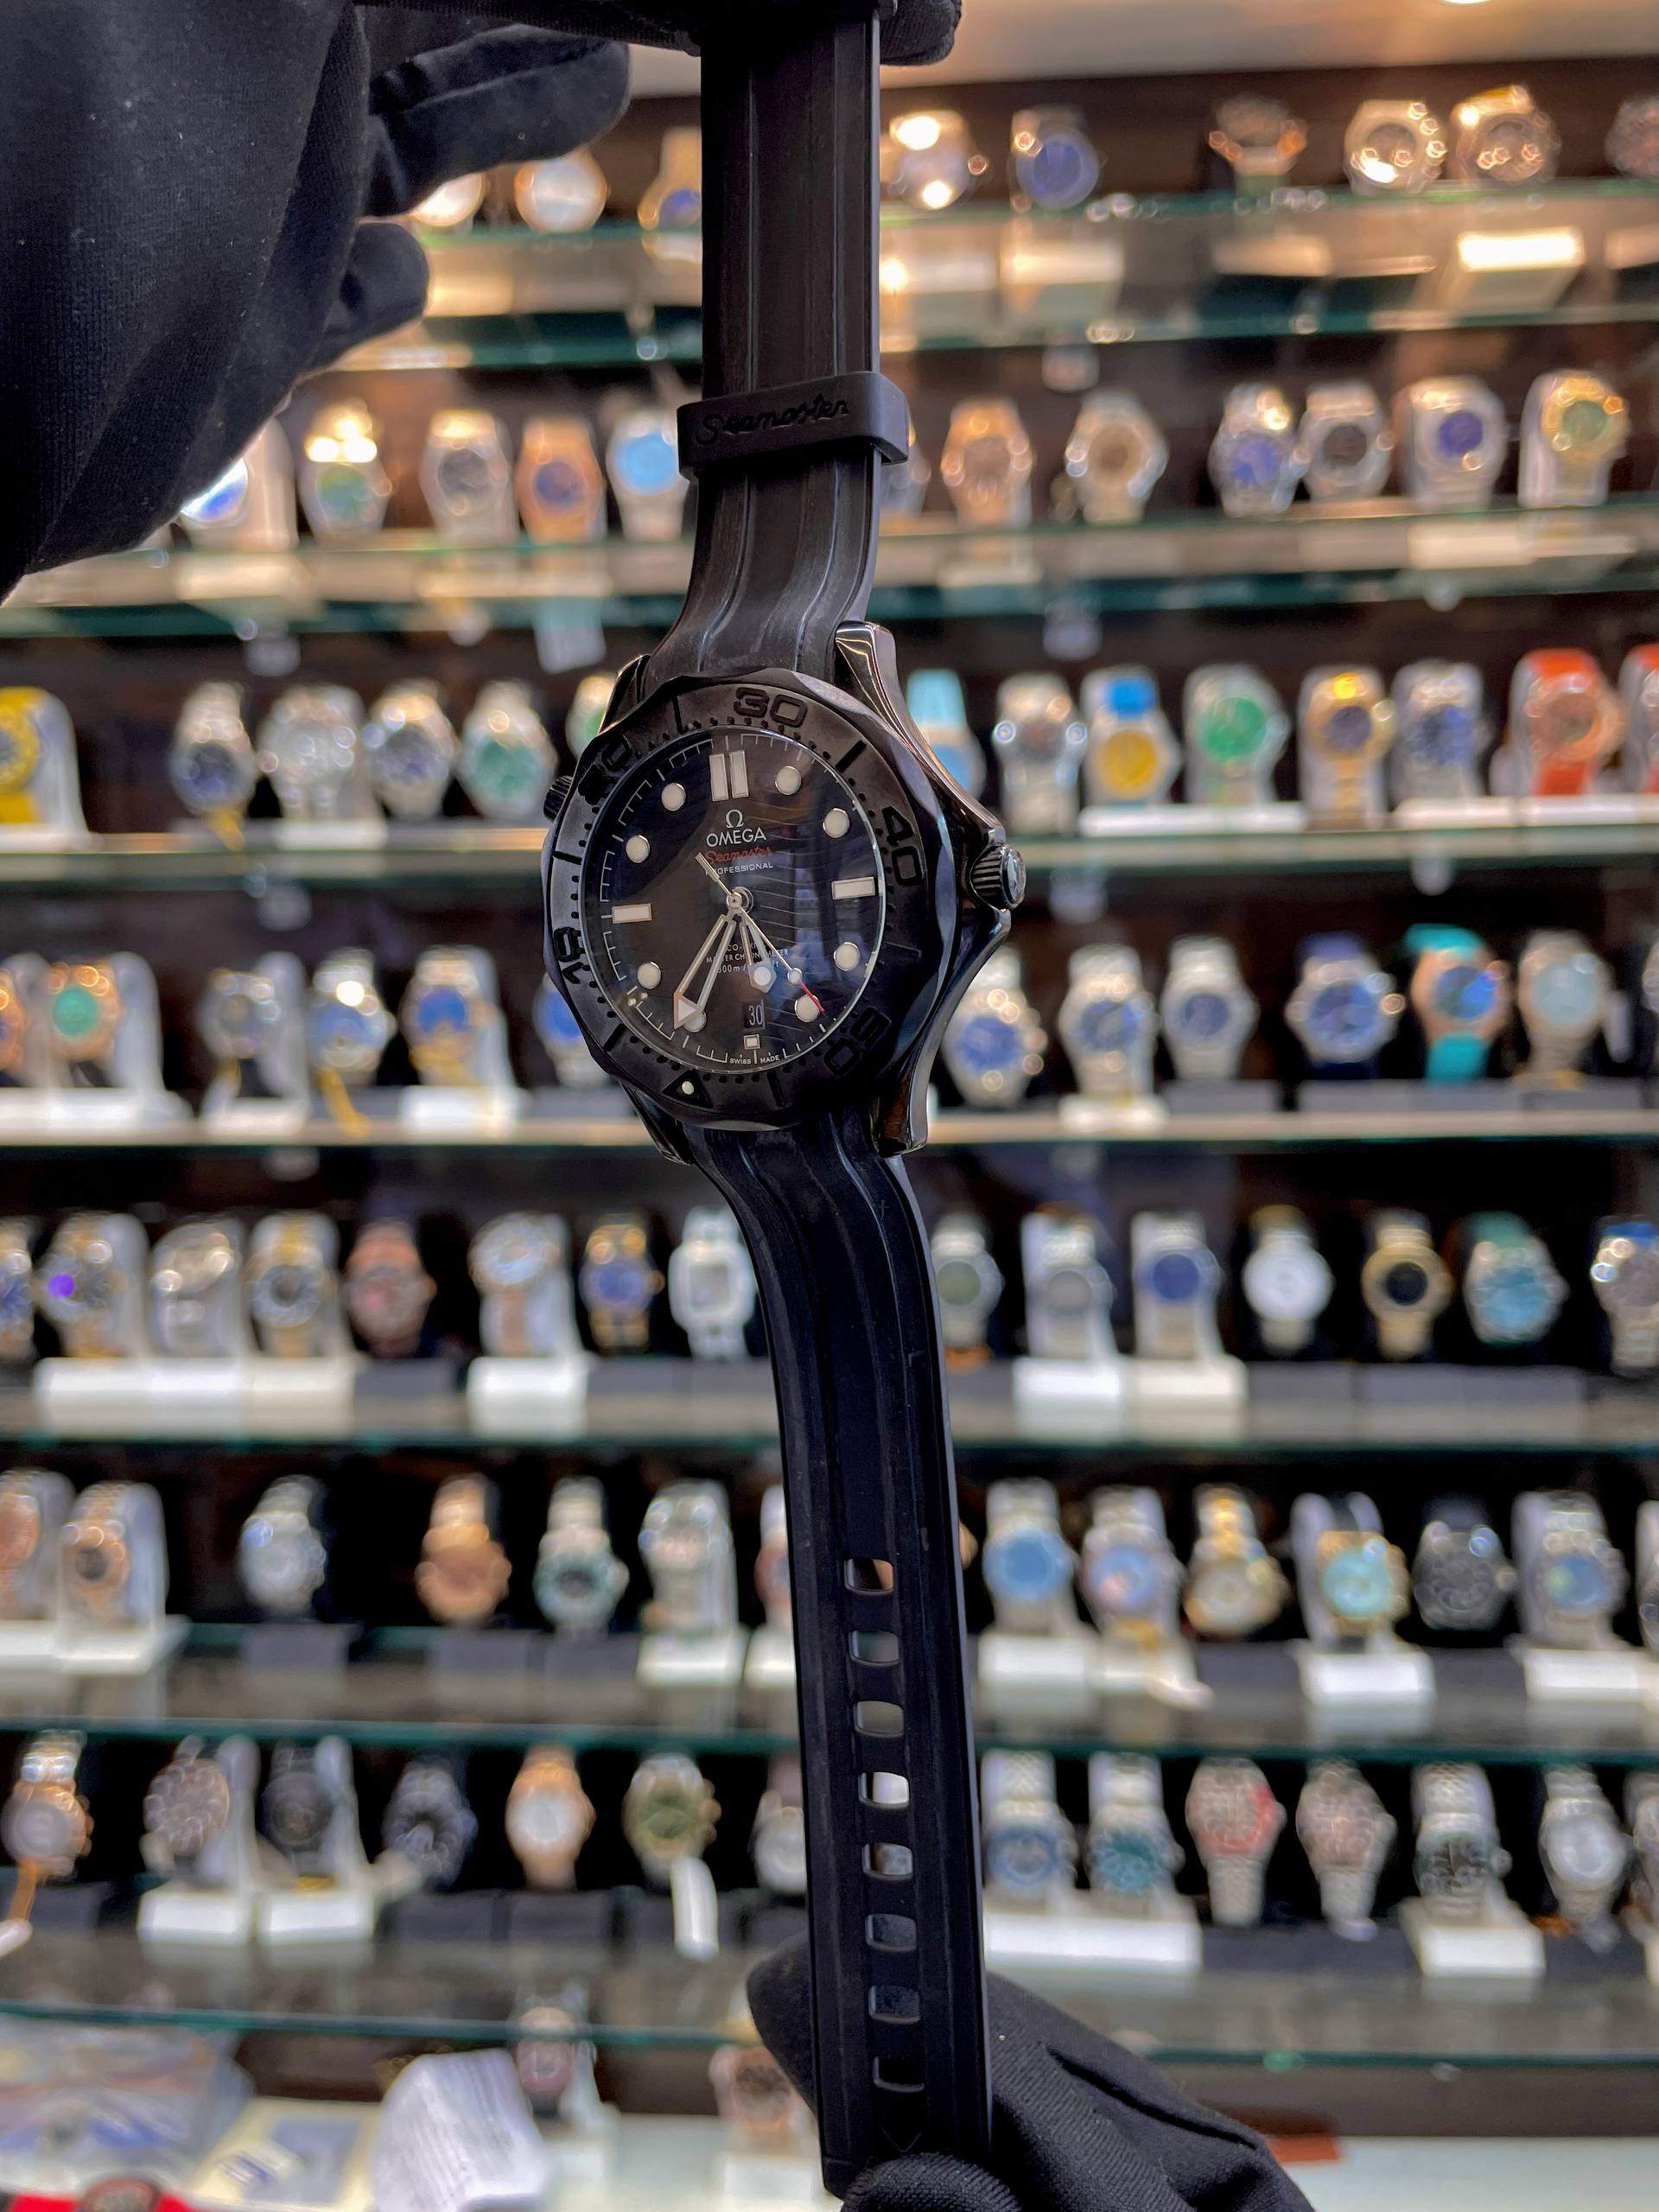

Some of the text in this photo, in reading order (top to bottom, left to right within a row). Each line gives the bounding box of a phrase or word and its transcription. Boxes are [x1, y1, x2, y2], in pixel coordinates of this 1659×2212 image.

[695, 393, 849, 446] Seamaster
[733, 687, 808, 728] 30
[706, 827, 767, 848] OMEGA
[881, 805, 922, 887] 40
[705, 846, 773, 865] Seamaster
[705, 862, 773, 876] OFESSIONAL
[747, 1003, 764, 1027] 30
[760, 1054, 780, 1065] MADE
